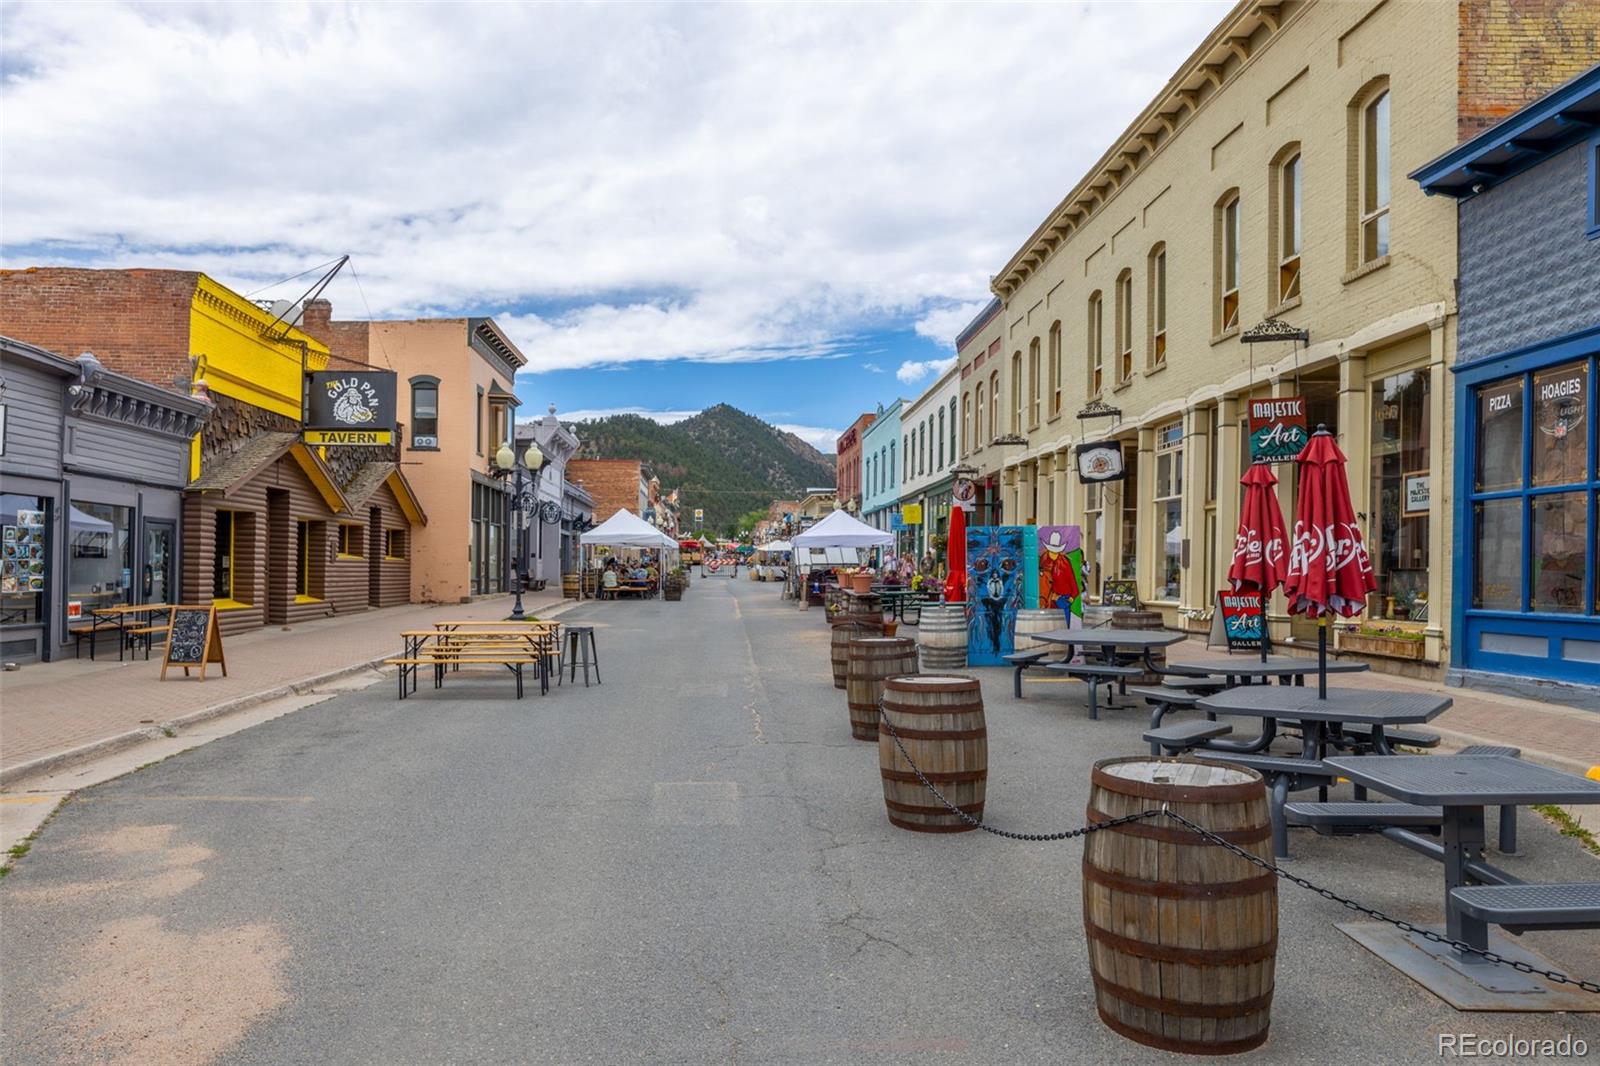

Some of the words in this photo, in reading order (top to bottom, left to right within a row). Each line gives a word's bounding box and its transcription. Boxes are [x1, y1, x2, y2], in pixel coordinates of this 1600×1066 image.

[327, 377, 358, 398] GOLD
[360, 382, 379, 406] PAN
[1541, 378, 1581, 400] HOAGIES
[1253, 401, 1302, 422] MAJESTIC
[1489, 394, 1511, 411] PIZZA
[319, 432, 377, 443] TAVERN
[1258, 423, 1300, 447] Art
[1224, 596, 1260, 611] MAJESTIC
[1231, 613, 1260, 630] Art
